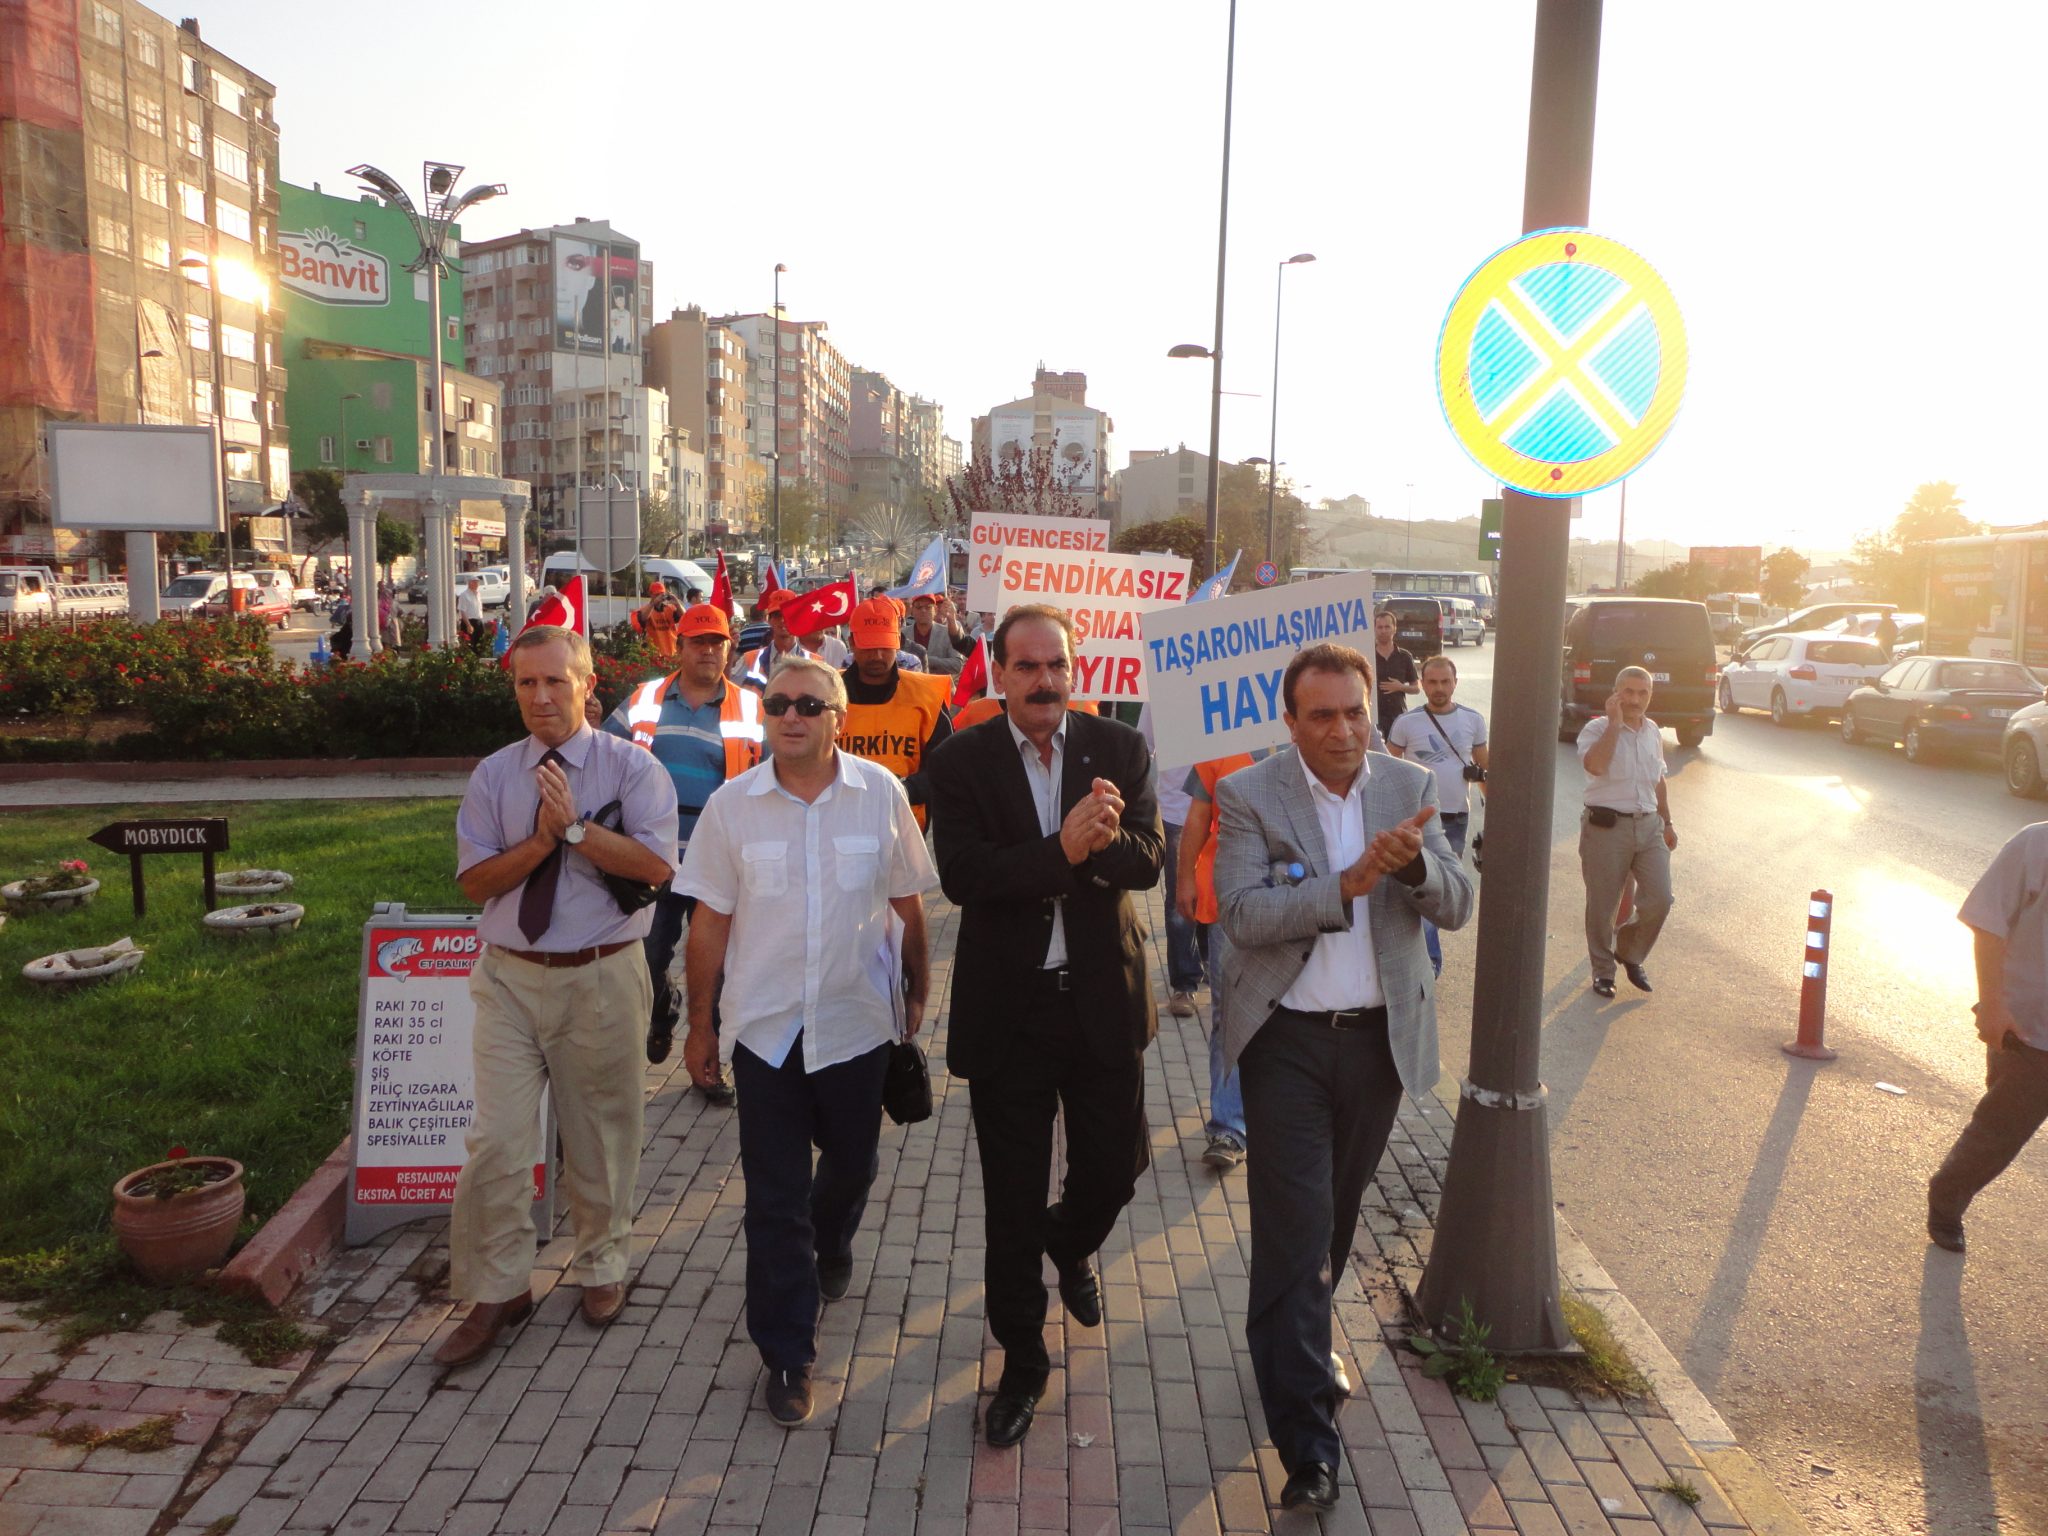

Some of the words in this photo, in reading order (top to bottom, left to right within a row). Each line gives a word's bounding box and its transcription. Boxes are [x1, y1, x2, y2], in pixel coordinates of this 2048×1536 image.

[279, 244, 380, 295] Banvit
[972, 522, 1106, 552] GÜVENCESİZ
[1003, 559, 1185, 600] SENDİKASIZ
[1149, 599, 1368, 676] TAŞARONLAŞMAYA
[124, 827, 207, 846] MOBYDICK
[435, 959, 470, 970] BALIK
[375, 1001, 404, 1012] RAKI
[410, 1001, 426, 1011] 70
[431, 1000, 444, 1011] cl
[374, 1017, 404, 1028] RAKI
[408, 1017, 425, 1028] 35
[430, 1017, 443, 1028] cl
[373, 1034, 403, 1045] RAKI
[407, 1034, 424, 1045] 20
[429, 1033, 442, 1044] cl
[372, 1048, 412, 1062] KÖFTE
[371, 1065, 390, 1079] ŞİŞ
[370, 1082, 402, 1097] PİLİÇ
[408, 1083, 458, 1095] IZGARA
[369, 1098, 474, 1113] ZEYTİNYAĞLILAR
[368, 1117, 403, 1129] BALIK
[408, 1115, 472, 1132] ÇEŞİTLERİ
[367, 1134, 447, 1146] SPESİYALLER
[357, 1188, 397, 1201] EKSTRA
[400, 1187, 435, 1200] ÜCRET
